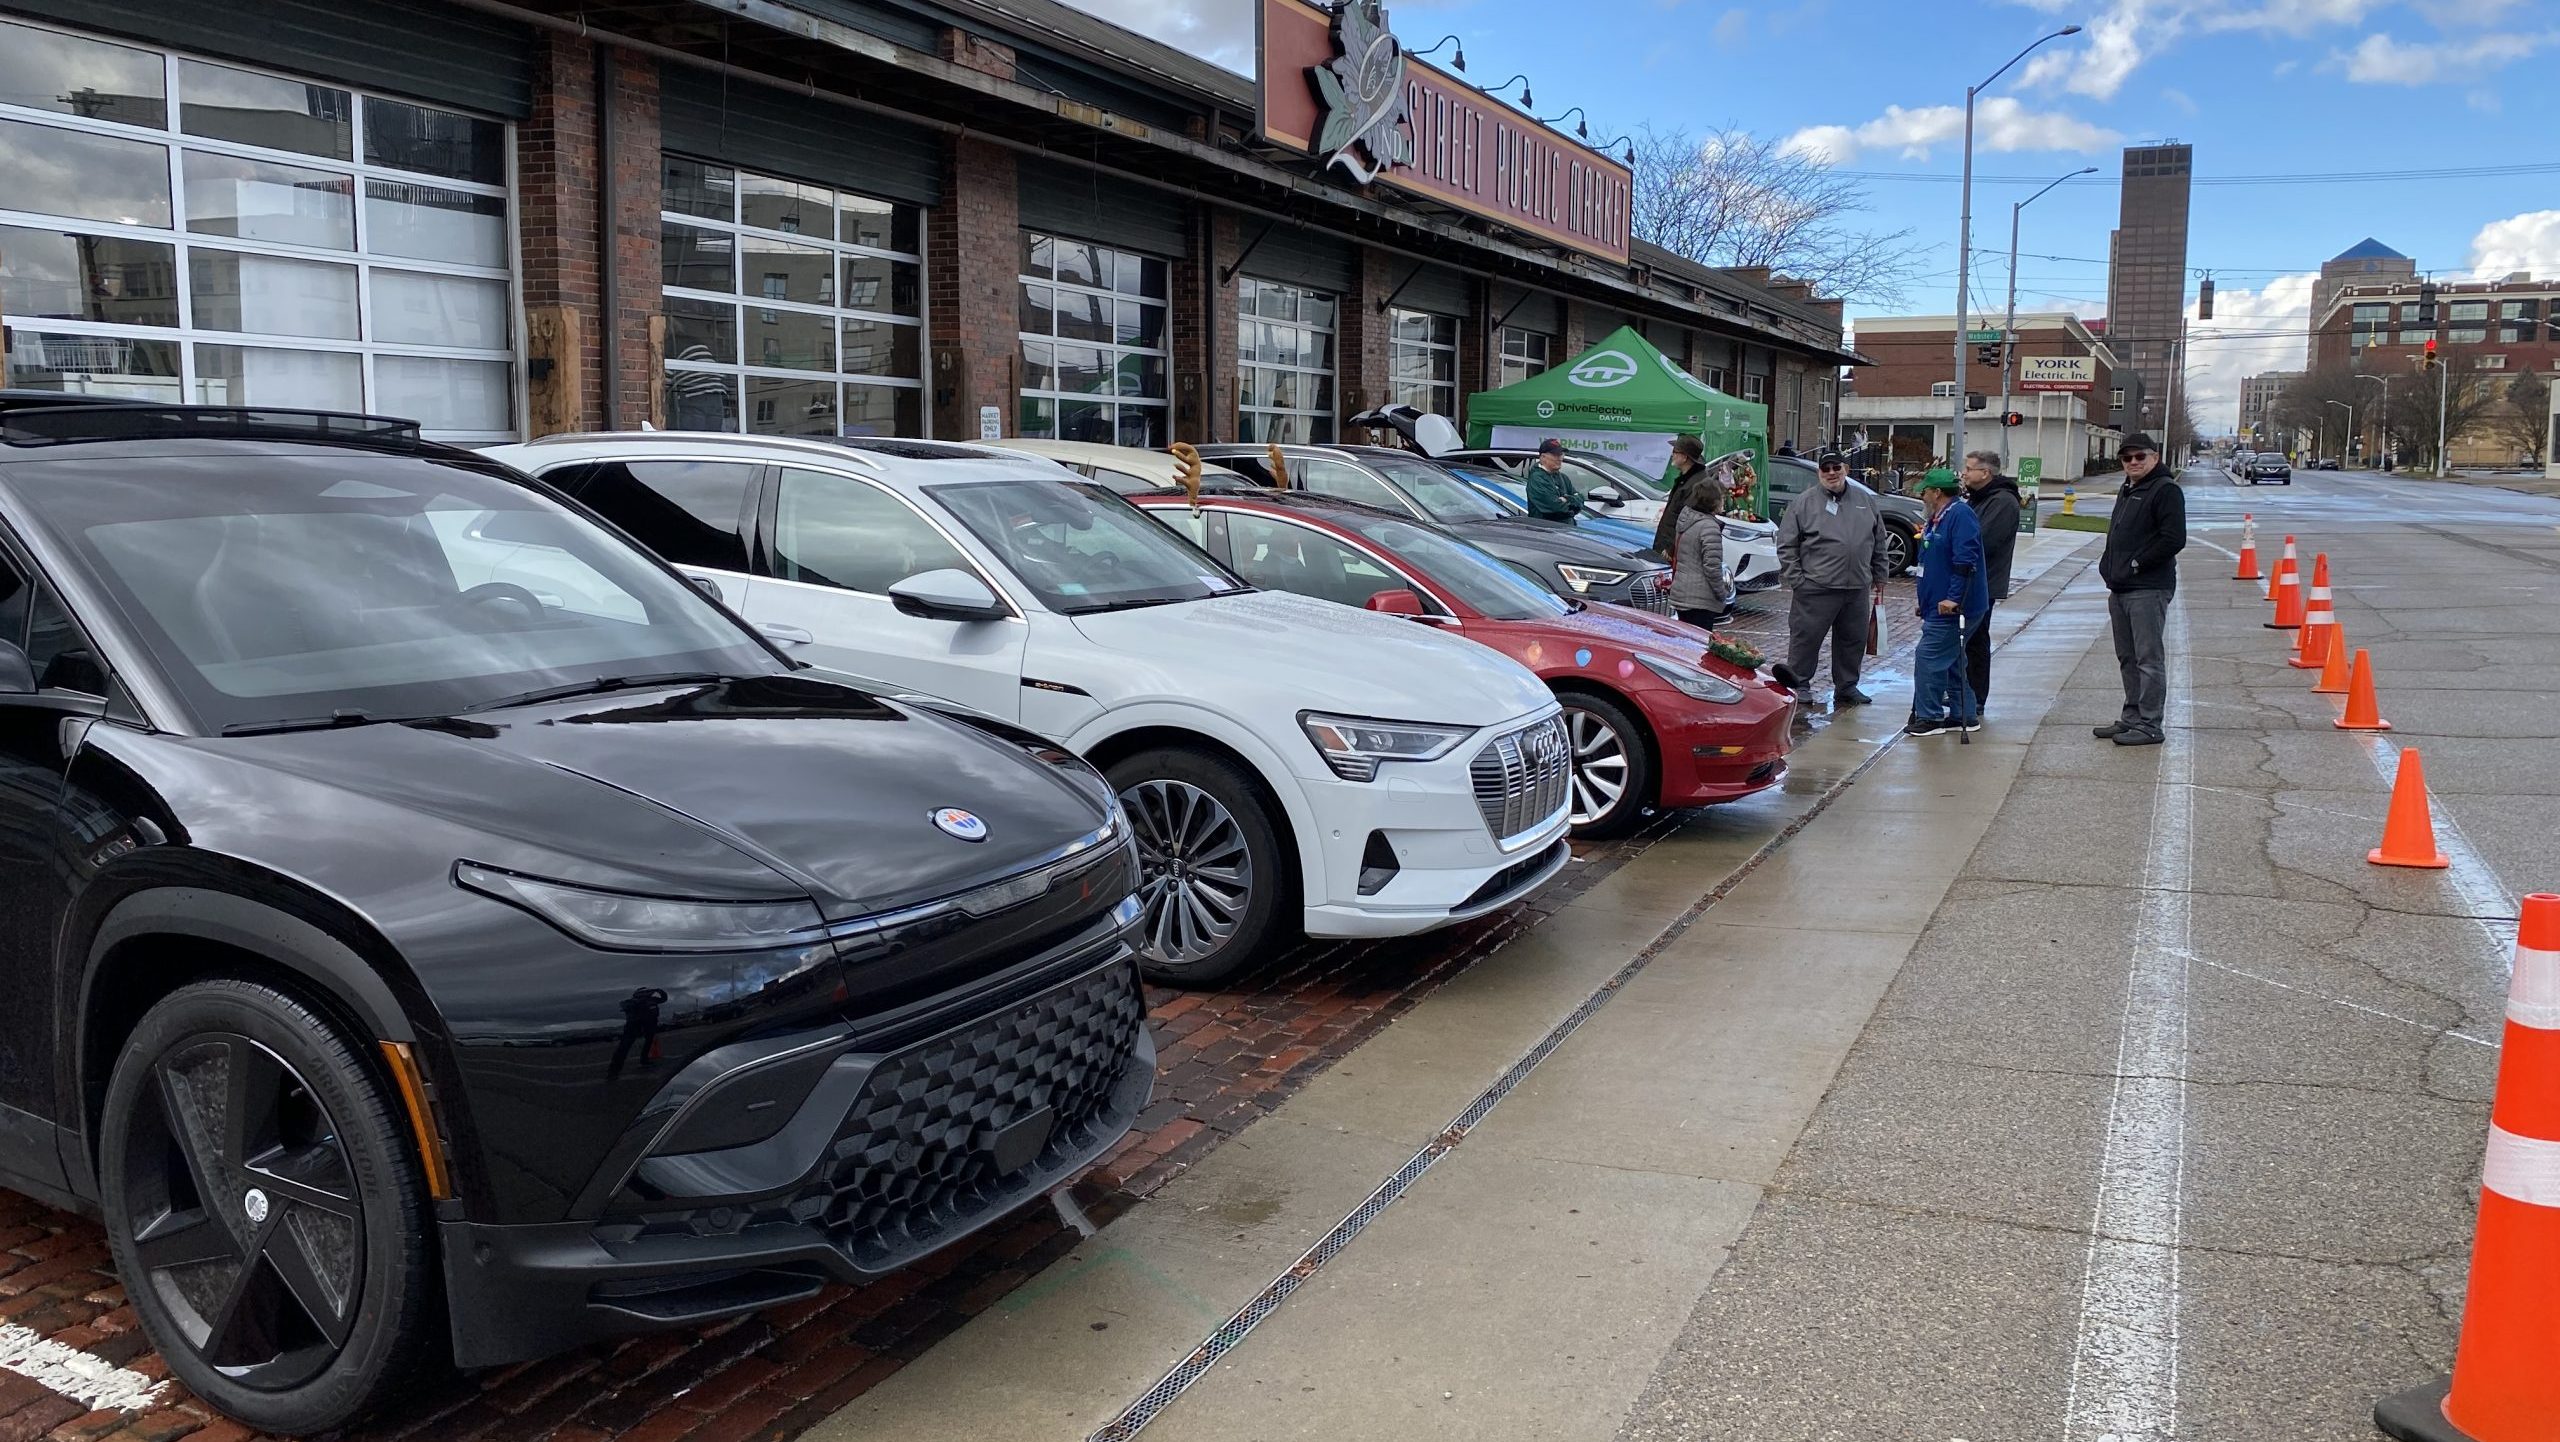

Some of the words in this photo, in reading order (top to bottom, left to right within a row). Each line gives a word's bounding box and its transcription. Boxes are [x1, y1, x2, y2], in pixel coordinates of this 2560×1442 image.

[1407, 79, 1484, 195] STREET
[1497, 122, 1560, 224] PUBLIC
[1569, 159, 1628, 249] MARKET
[2035, 359, 2080, 369] YORK
[1557, 403, 1632, 416] DriveElectric
[1599, 415, 1632, 423] DAYTON
[1602, 440, 1629, 451] Tent
[2018, 474, 2038, 483] Link
[308, 1057, 379, 1201] BRIDGESTONE
